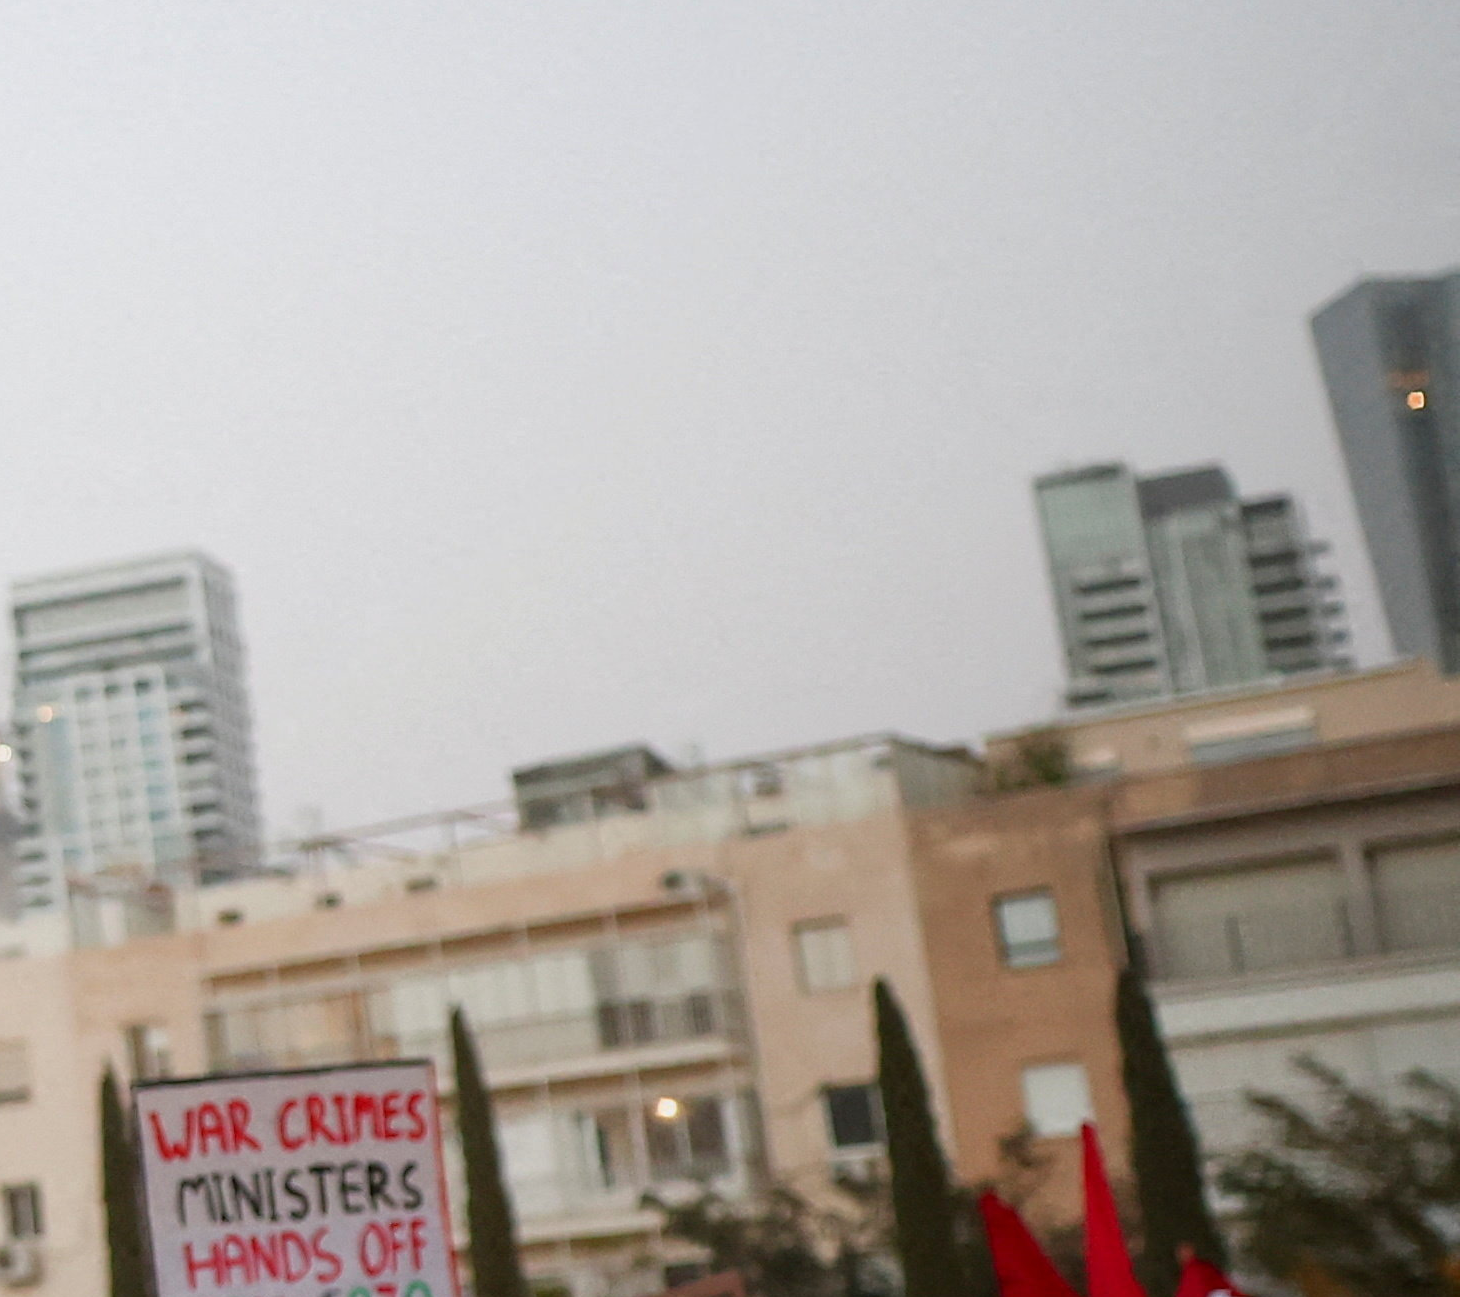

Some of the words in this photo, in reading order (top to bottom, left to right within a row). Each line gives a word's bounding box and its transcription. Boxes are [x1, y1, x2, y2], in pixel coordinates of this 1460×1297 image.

[148, 1095, 263, 1162] WAR
[277, 1089, 429, 1151] CRIMES
[178, 1161, 423, 1228] MINISTERS
[183, 1228, 343, 1289] HANDS
[358, 1220, 429, 1280] OFF
